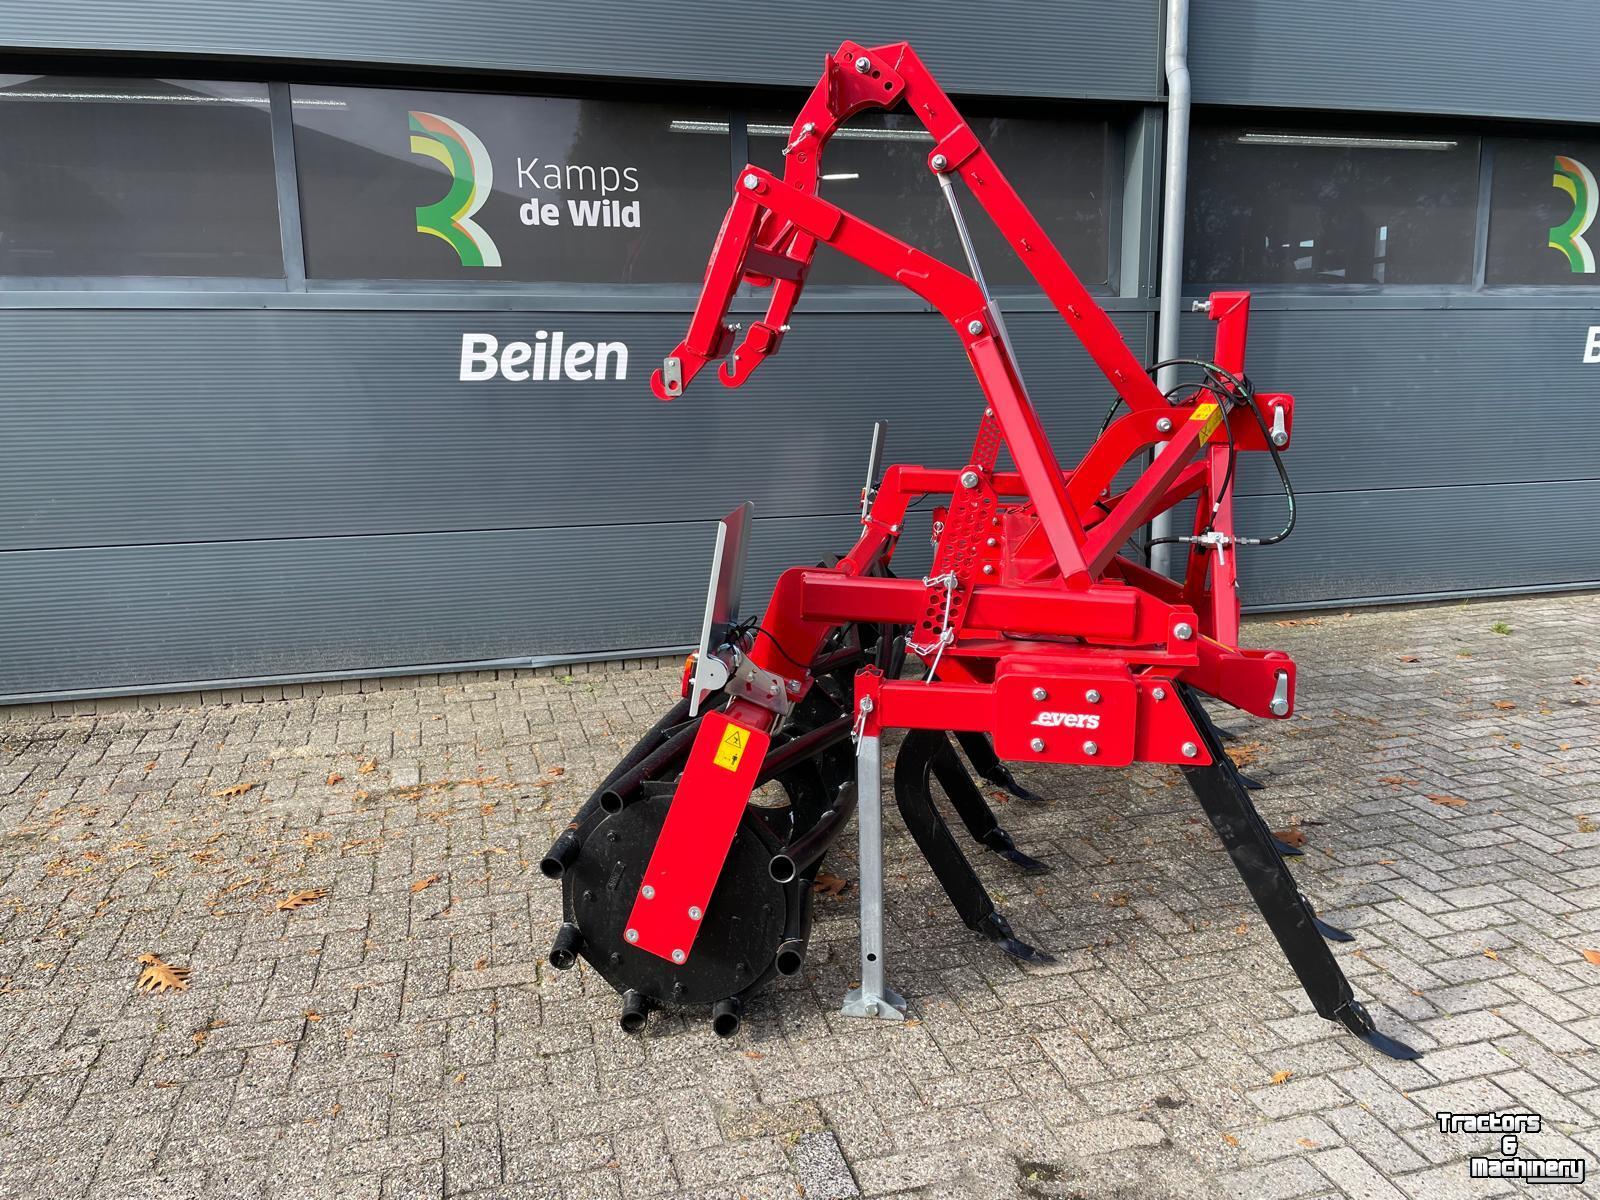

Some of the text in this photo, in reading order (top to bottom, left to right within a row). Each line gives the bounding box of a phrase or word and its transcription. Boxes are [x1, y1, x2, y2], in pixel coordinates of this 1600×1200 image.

[517, 157, 640, 196] Kamps
[519, 198, 641, 228] de Wild
[459, 330, 629, 382] Beilen
[1030, 711, 1101, 729] evers
